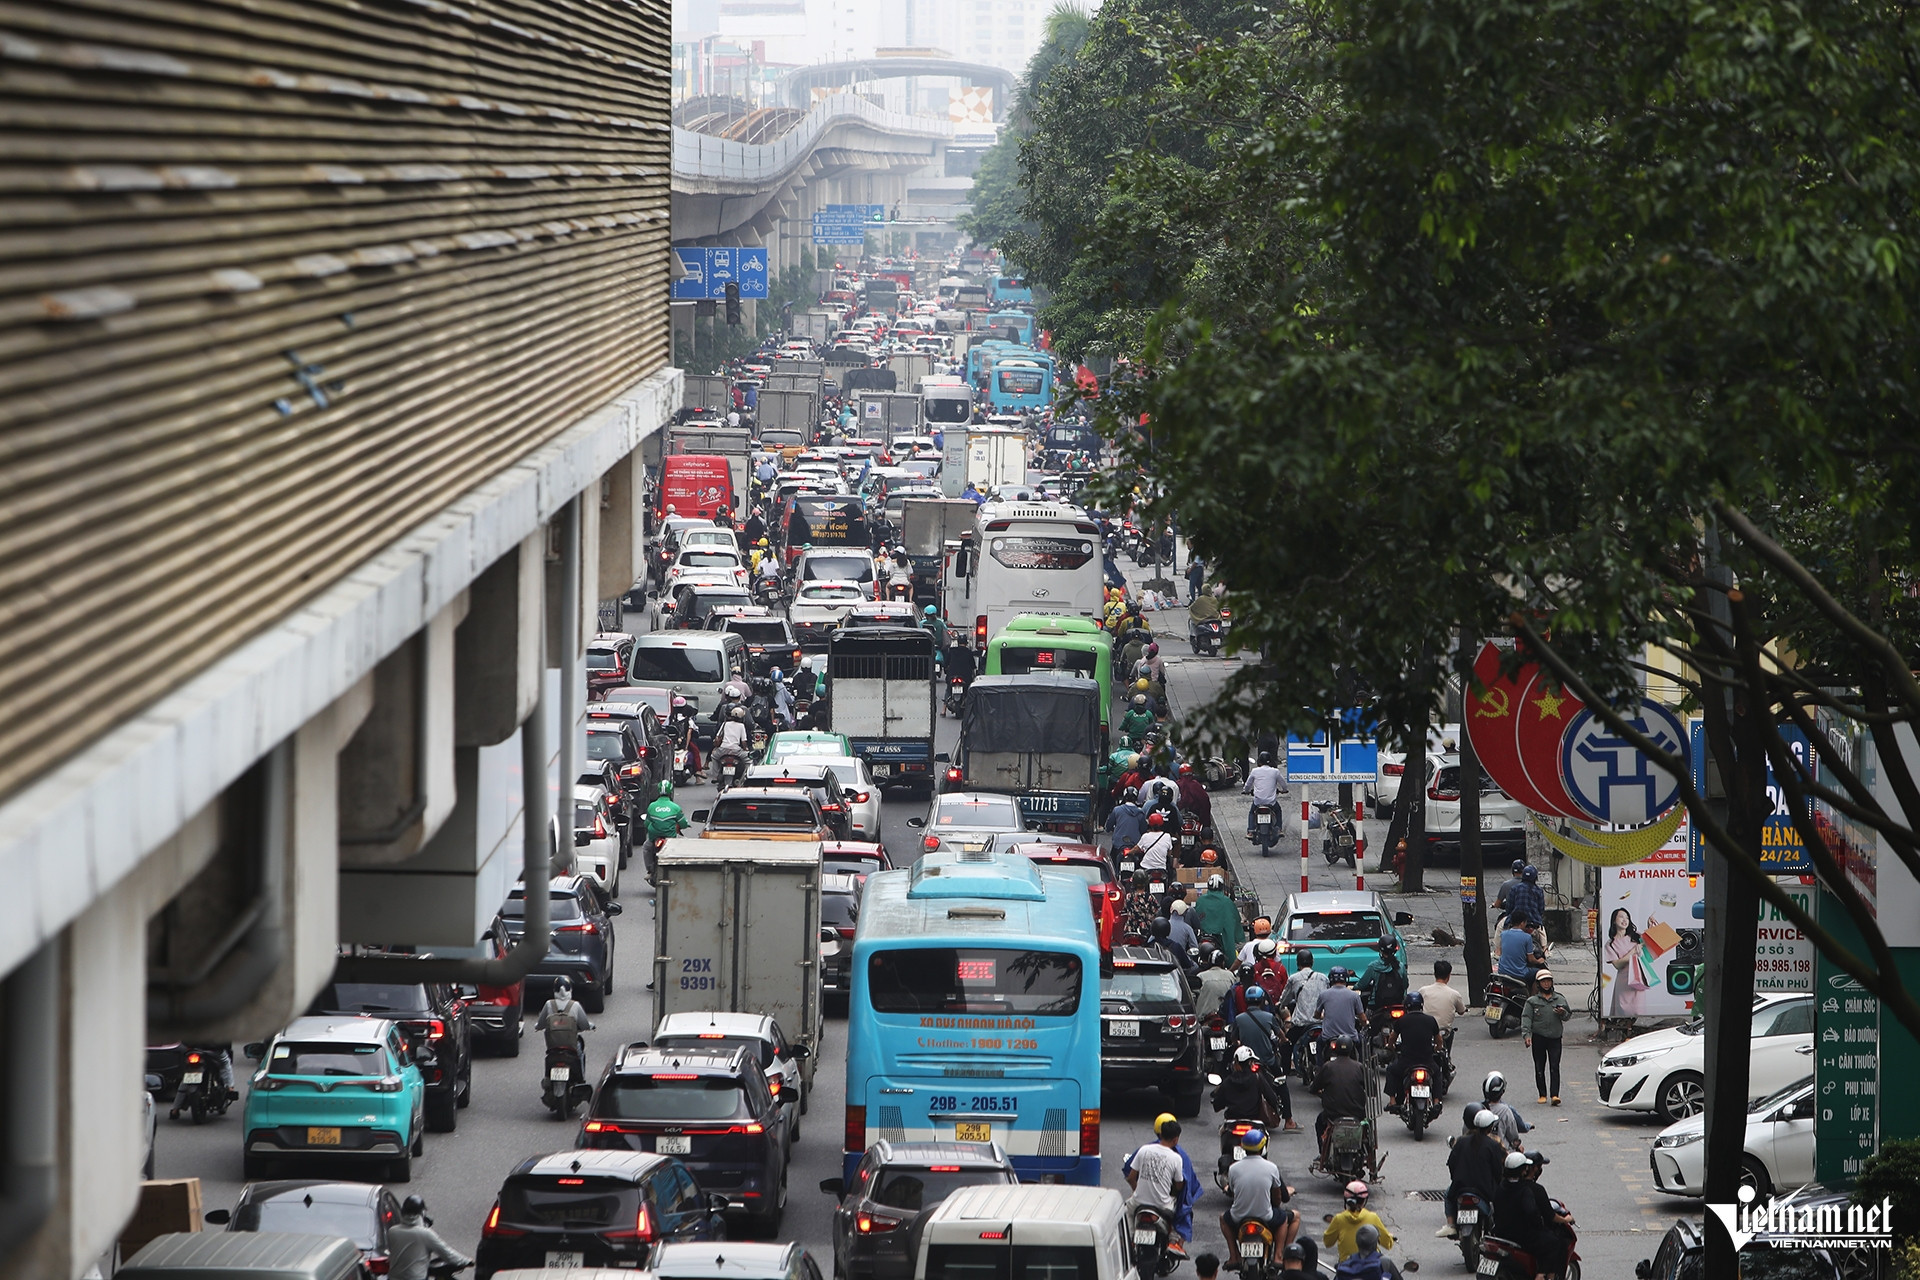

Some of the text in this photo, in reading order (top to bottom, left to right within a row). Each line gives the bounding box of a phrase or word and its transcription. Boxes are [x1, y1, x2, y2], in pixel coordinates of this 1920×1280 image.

[1030, 797, 1058, 811] 177.15
[1760, 850, 1800, 862] 24/24
[1619, 868, 1636, 879] ÂM
[1639, 869, 1675, 878] THANH
[1769, 943, 1784, 954] SỞ
[1788, 946, 1794, 954] 3
[683, 959, 711, 972] 29X
[681, 976, 715, 990] 9391
[1756, 976, 1808, 988] TRẦN PHÚ
[1864, 997, 1875, 1013] SÓC
[936, 1017, 955, 1028] BUS
[958, 1018, 994, 1028] NHANH
[998, 1016, 1012, 1028] HÀ
[1014, 1017, 1035, 1032] NỘI
[1845, 1024, 1856, 1042] BẢO
[927, 1038, 1037, 1049] Hotline: 1900 1296
[1845, 1081, 1858, 1098] PHỤ
[930, 1096, 956, 1111] 29B
[972, 1097, 1017, 1112] 205.51
[1851, 1103, 1869, 1121] LỐP XE
[966, 1124, 980, 1132] 29B
[666, 1137, 680, 1145] 30L
[959, 1132, 986, 1141] 205.51
